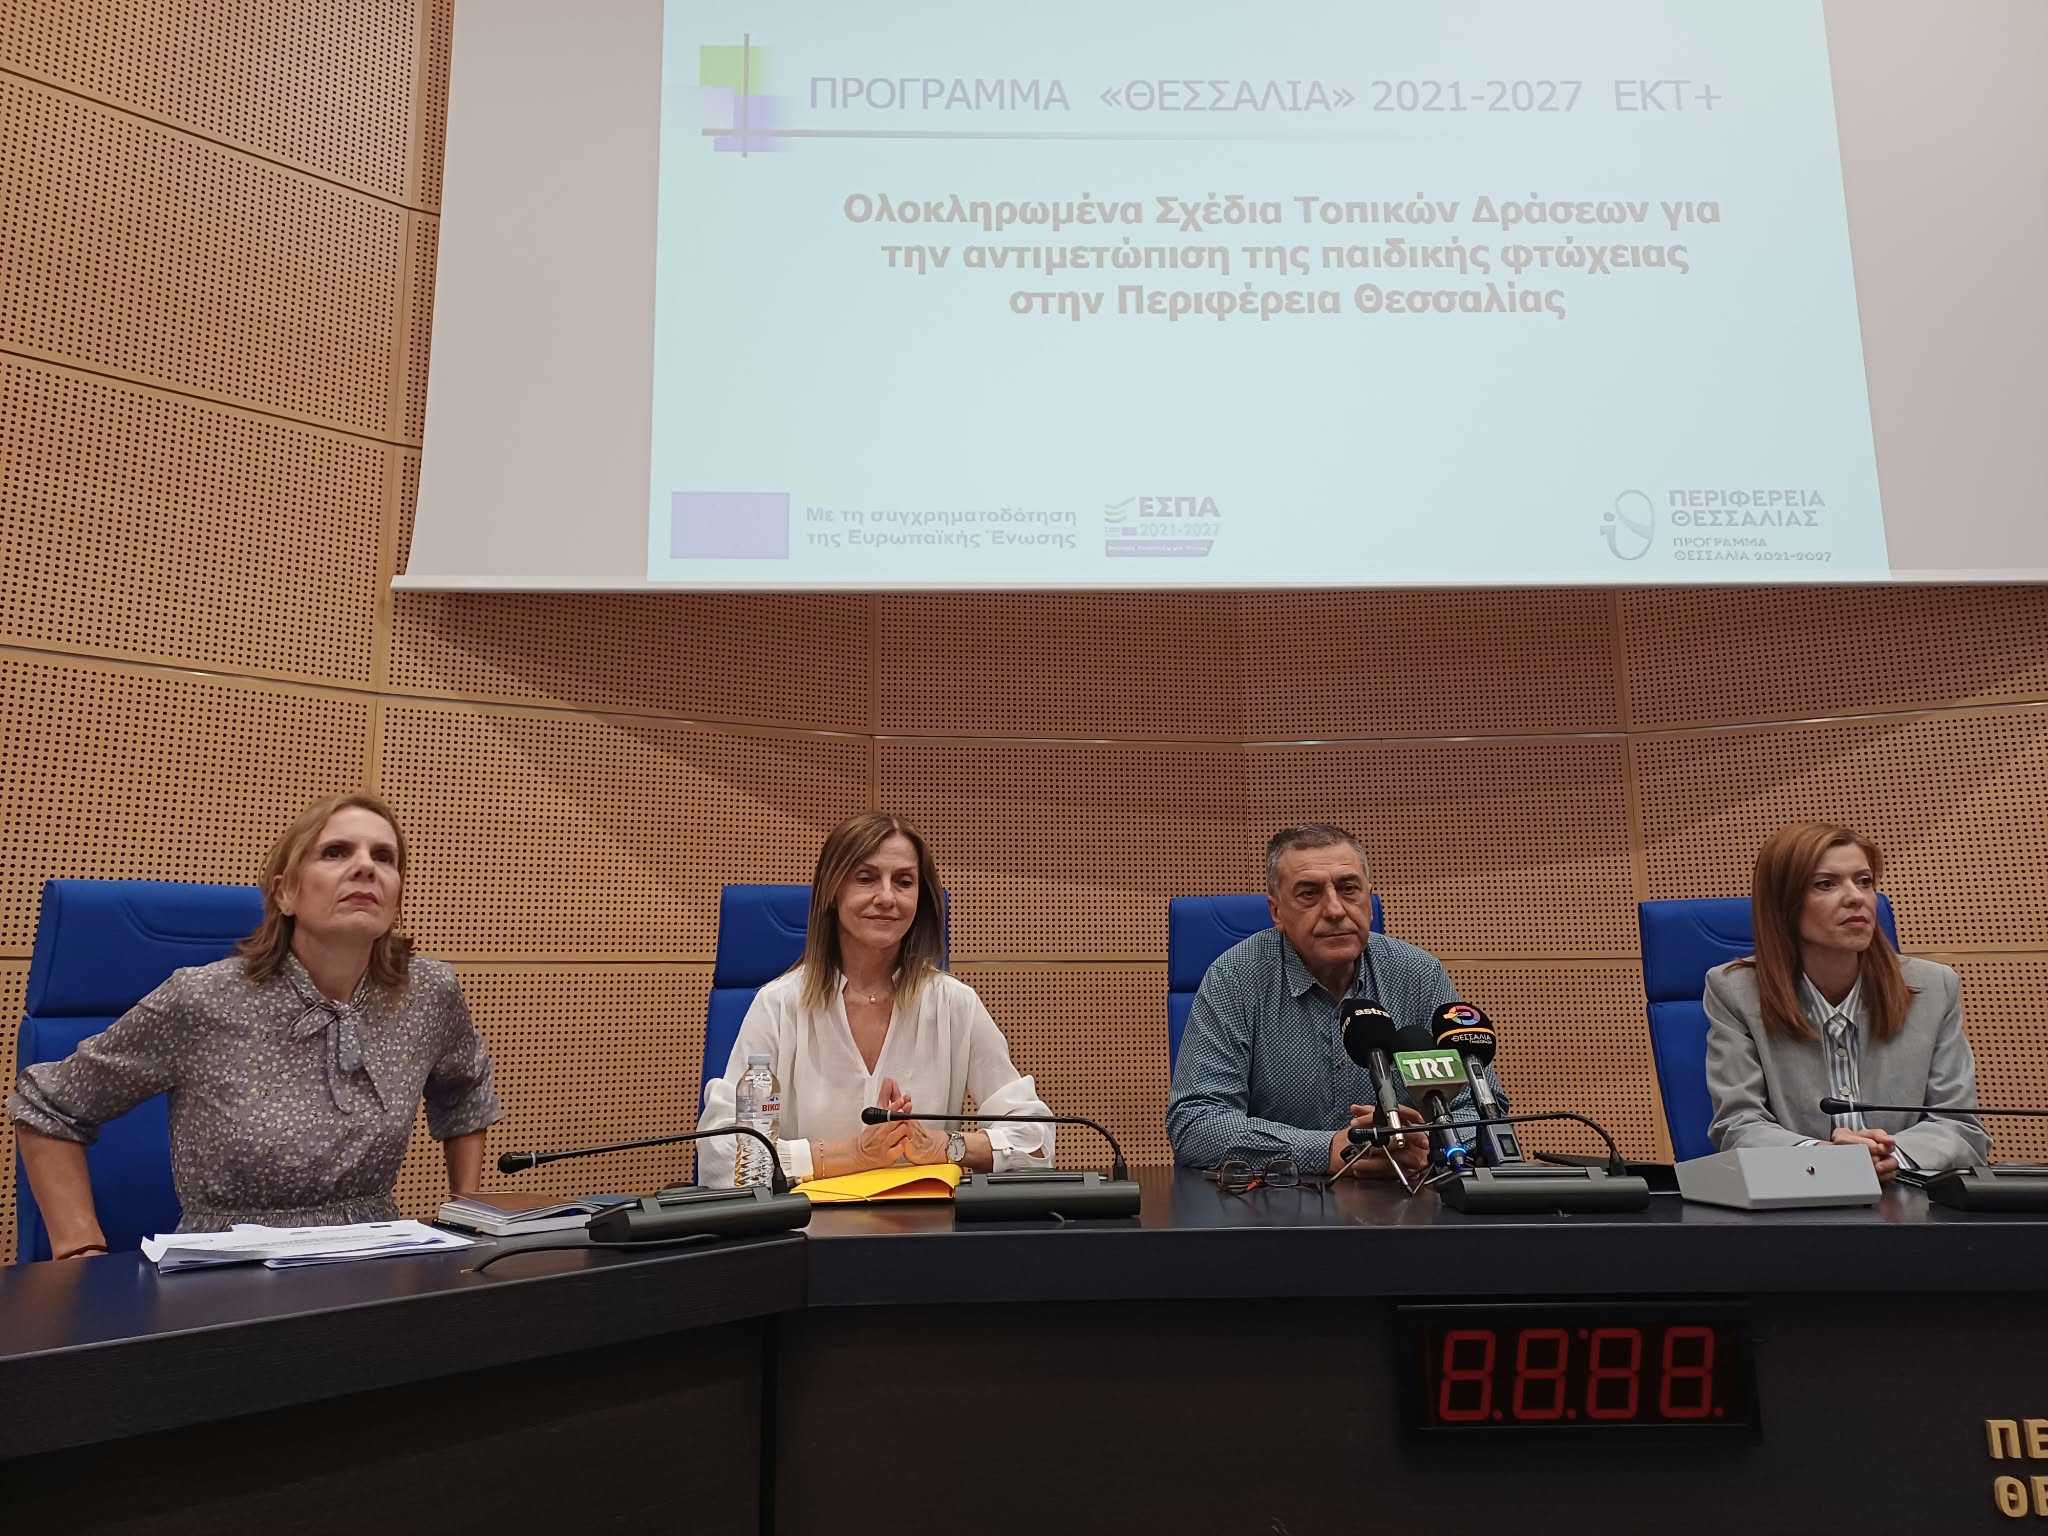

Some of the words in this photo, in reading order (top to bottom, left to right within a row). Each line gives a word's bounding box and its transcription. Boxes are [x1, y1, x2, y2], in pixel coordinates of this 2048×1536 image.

[811, 77, 1070, 111] ΠΡΟΓΡΑΜΜΑ
[1100, 79, 1355, 112] «ΘΕΣΣΑΛΙΑ»
[1371, 80, 1582, 112] 2021-2027
[1615, 80, 1722, 112] ΕΚΤ+
[844, 192, 1143, 231] Ολοκληρωμένα
[1155, 192, 1282, 231] Σχέδια
[1293, 192, 1460, 224] Τοπικών
[1472, 192, 1647, 231] Δράσεων
[1660, 200, 1720, 231] για
[881, 244, 952, 274] την
[963, 236, 1230, 275] αντιμετώπιση
[1241, 245, 1310, 275] της
[1322, 235, 1490, 274] παιδικής
[1500, 236, 1689, 275] φτώχειας
[1009, 291, 1104, 321] στην
[1118, 281, 1341, 321] Περιφέρεια
[1354, 281, 1566, 320] Θεσσαλίας
[1139, 496, 1221, 518] ΕΣΠΑ
[1669, 489, 1826, 508] ΠΕΡΙΦΕΡΕΙΑ
[806, 507, 834, 522] Με
[840, 510, 864, 526] τη
[871, 507, 1077, 527] συγχρηματοδότηση
[1671, 509, 1818, 527] ΘΕΣΣΑΛΙΑΣ
[806, 531, 840, 548] της
[848, 529, 981, 549] Ευρωπαϊκής
[985, 529, 1077, 549] Ένωσης
[1139, 522, 1221, 537] 2021-2027
[1673, 537, 1768, 548] ΠΡΟΓΡΑΜΜΑ
[1673, 549, 1750, 561] ΘΕΣΣΑΛΙΑ
[1753, 551, 1832, 563] 2021-2027
[1354, 1007, 1391, 1018] astra
[1402, 1056, 1455, 1080] TRT
